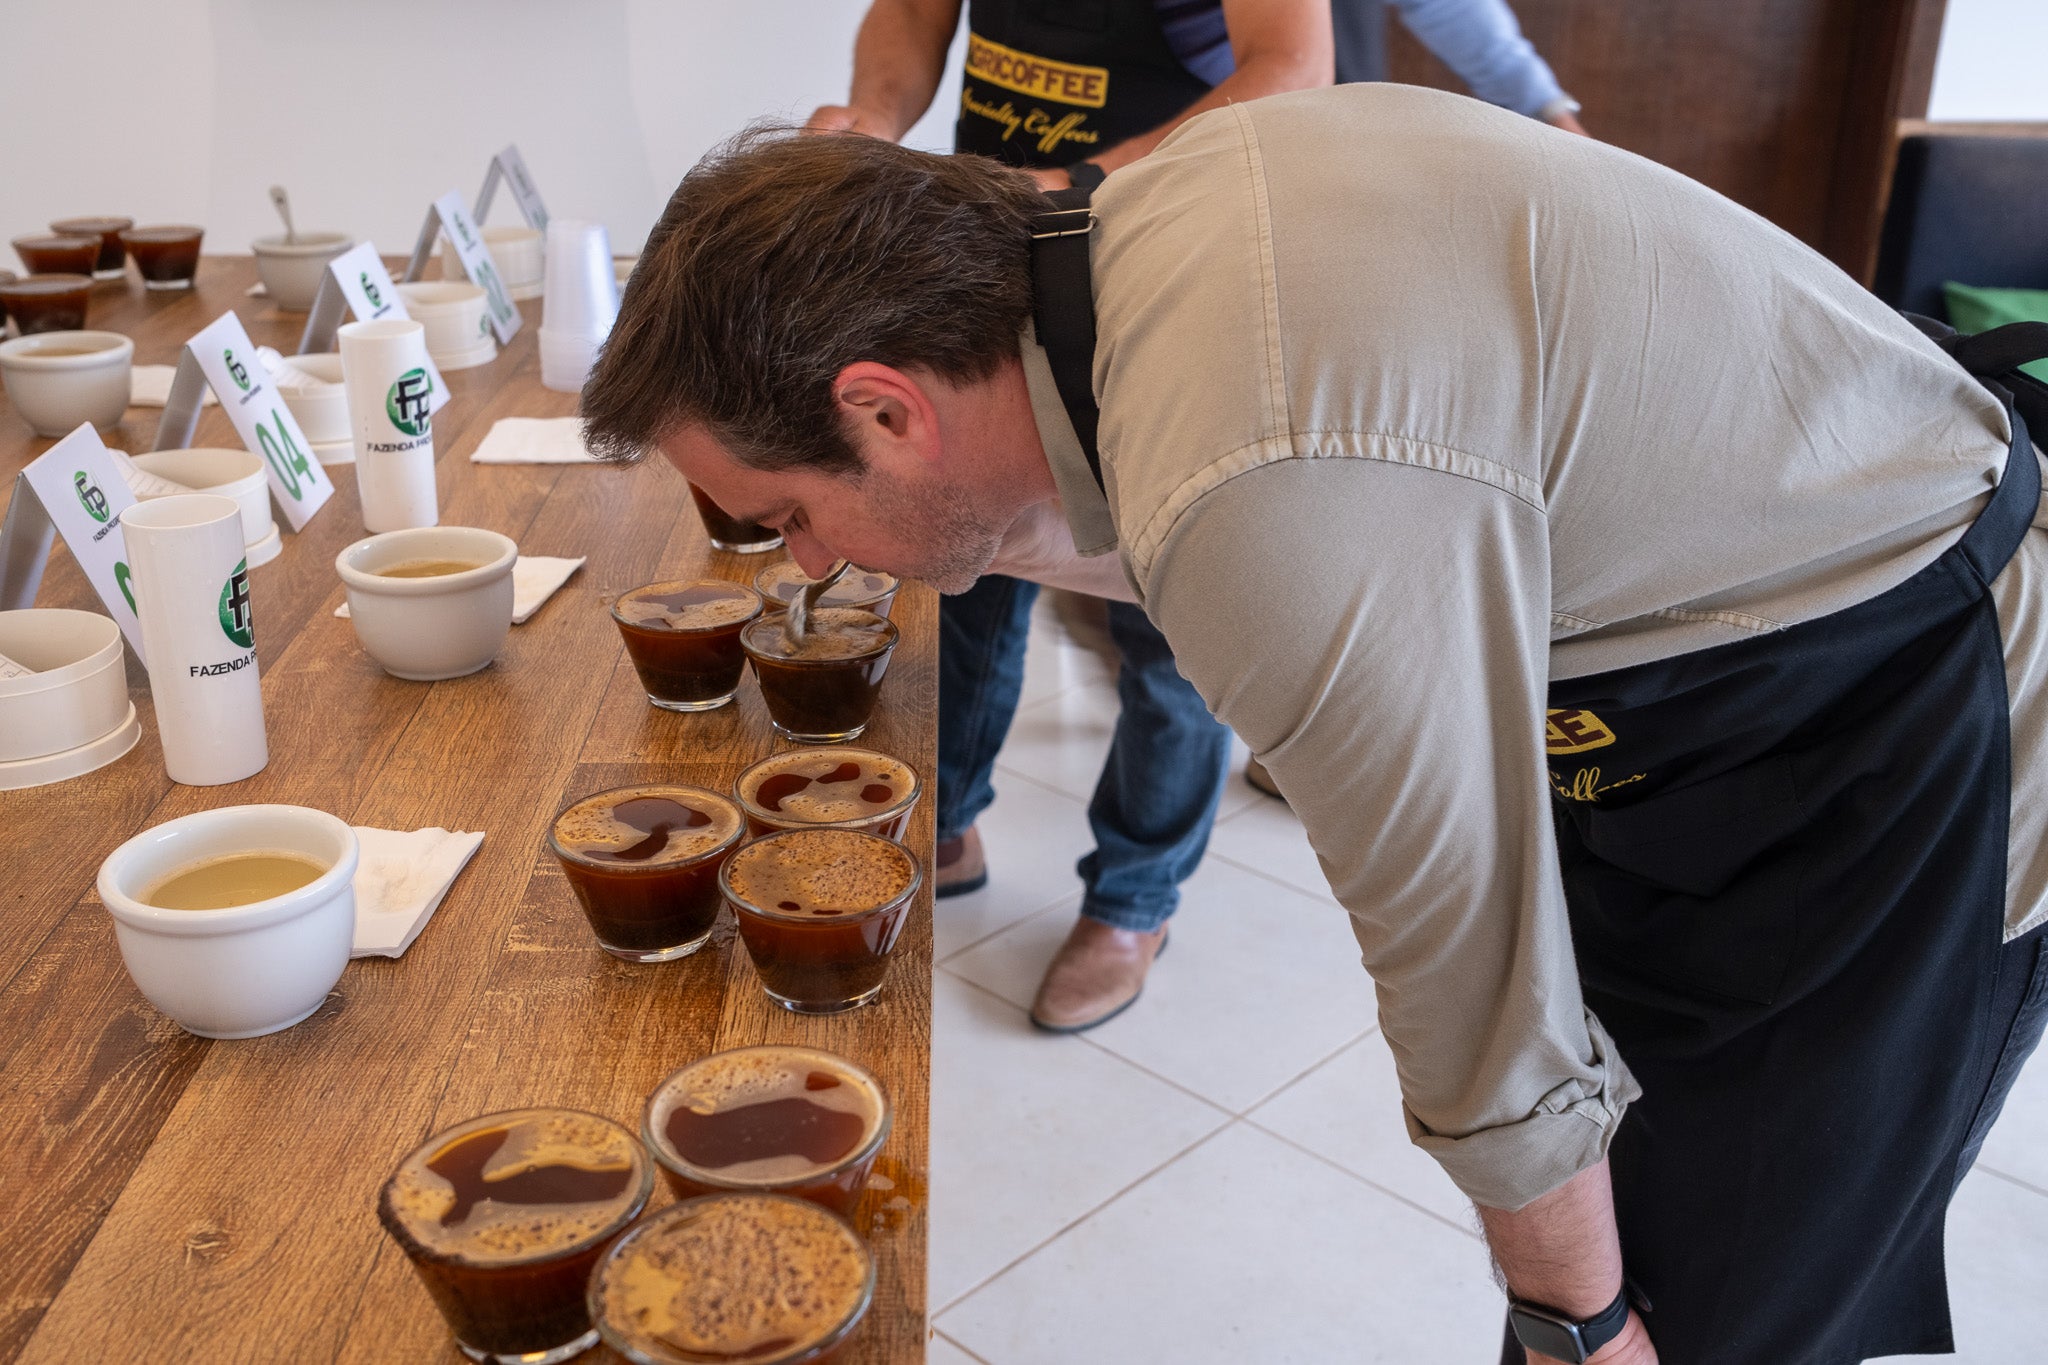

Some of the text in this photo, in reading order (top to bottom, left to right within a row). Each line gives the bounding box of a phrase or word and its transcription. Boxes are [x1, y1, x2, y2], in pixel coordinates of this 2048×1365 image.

[970, 44, 1103, 101] GRICOFFEE
[256, 408, 316, 502] 04
[367, 441, 415, 453] FAZENDA
[190, 655, 250, 677] FAZENDA
